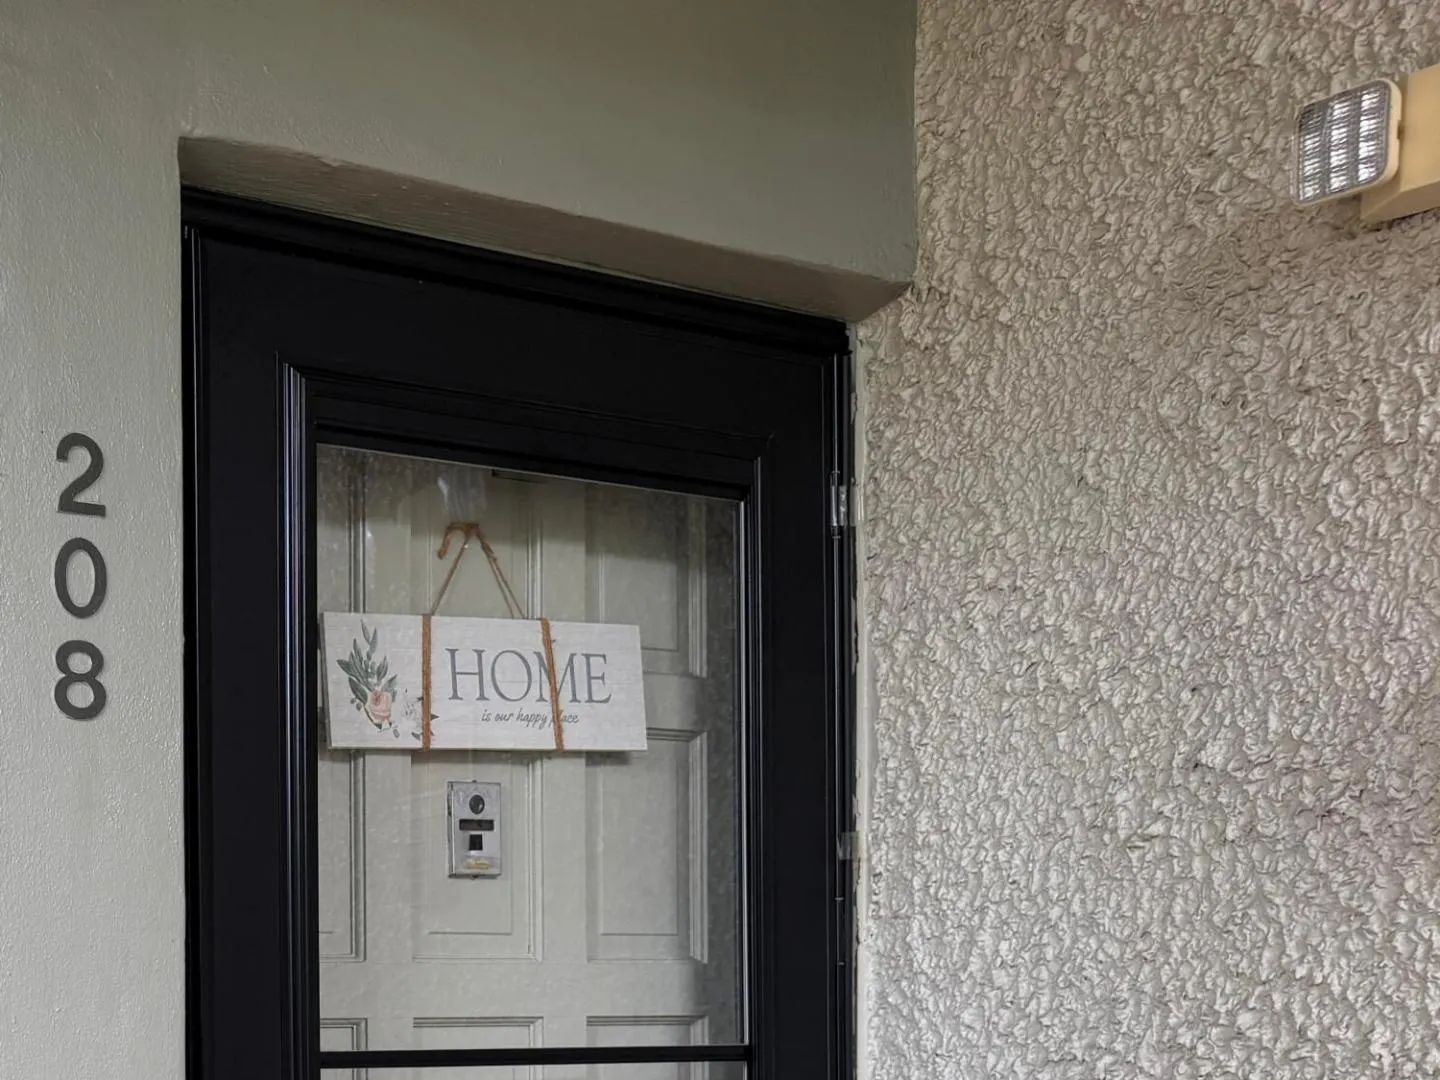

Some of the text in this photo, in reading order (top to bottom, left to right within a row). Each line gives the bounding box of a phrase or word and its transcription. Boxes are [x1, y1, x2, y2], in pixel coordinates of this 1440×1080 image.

[54, 432, 107, 721] 208
[445, 648, 611, 704] HOME
[481, 707, 579, 730] is our happy ace
